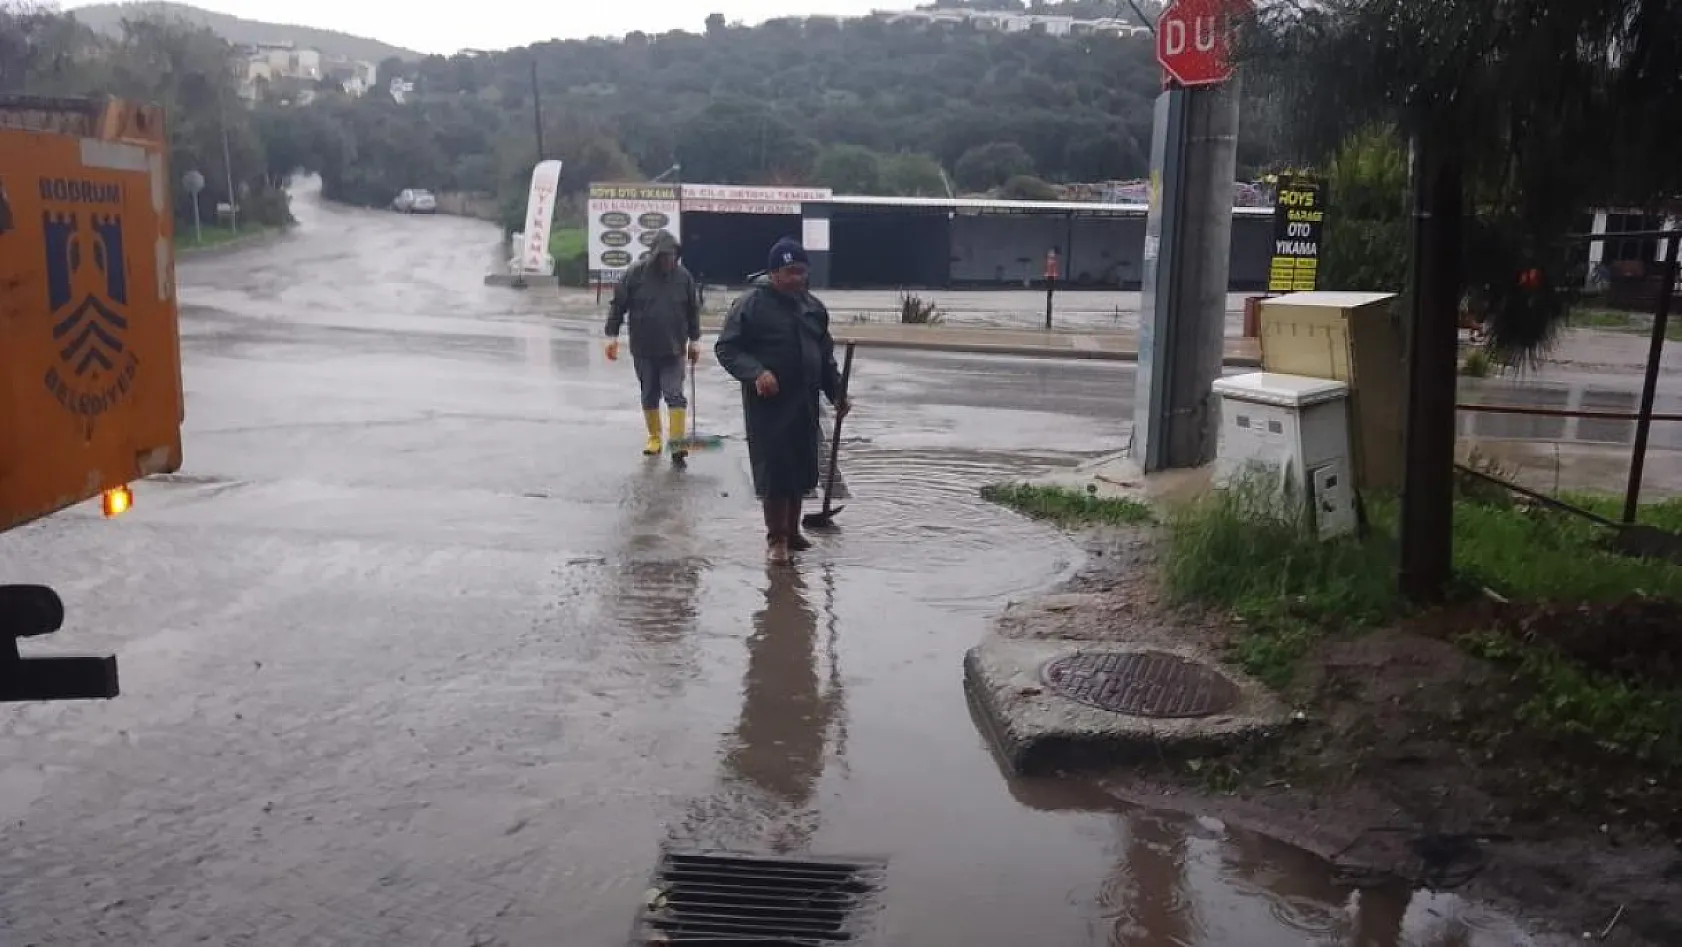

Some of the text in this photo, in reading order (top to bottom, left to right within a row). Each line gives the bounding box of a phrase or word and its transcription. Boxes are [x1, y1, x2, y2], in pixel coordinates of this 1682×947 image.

[39, 176, 121, 203] BODRUM
[1279, 189, 1315, 207] ROYS
[1287, 222, 1311, 237] OTO
[1276, 240, 1317, 255] YIKAMA
